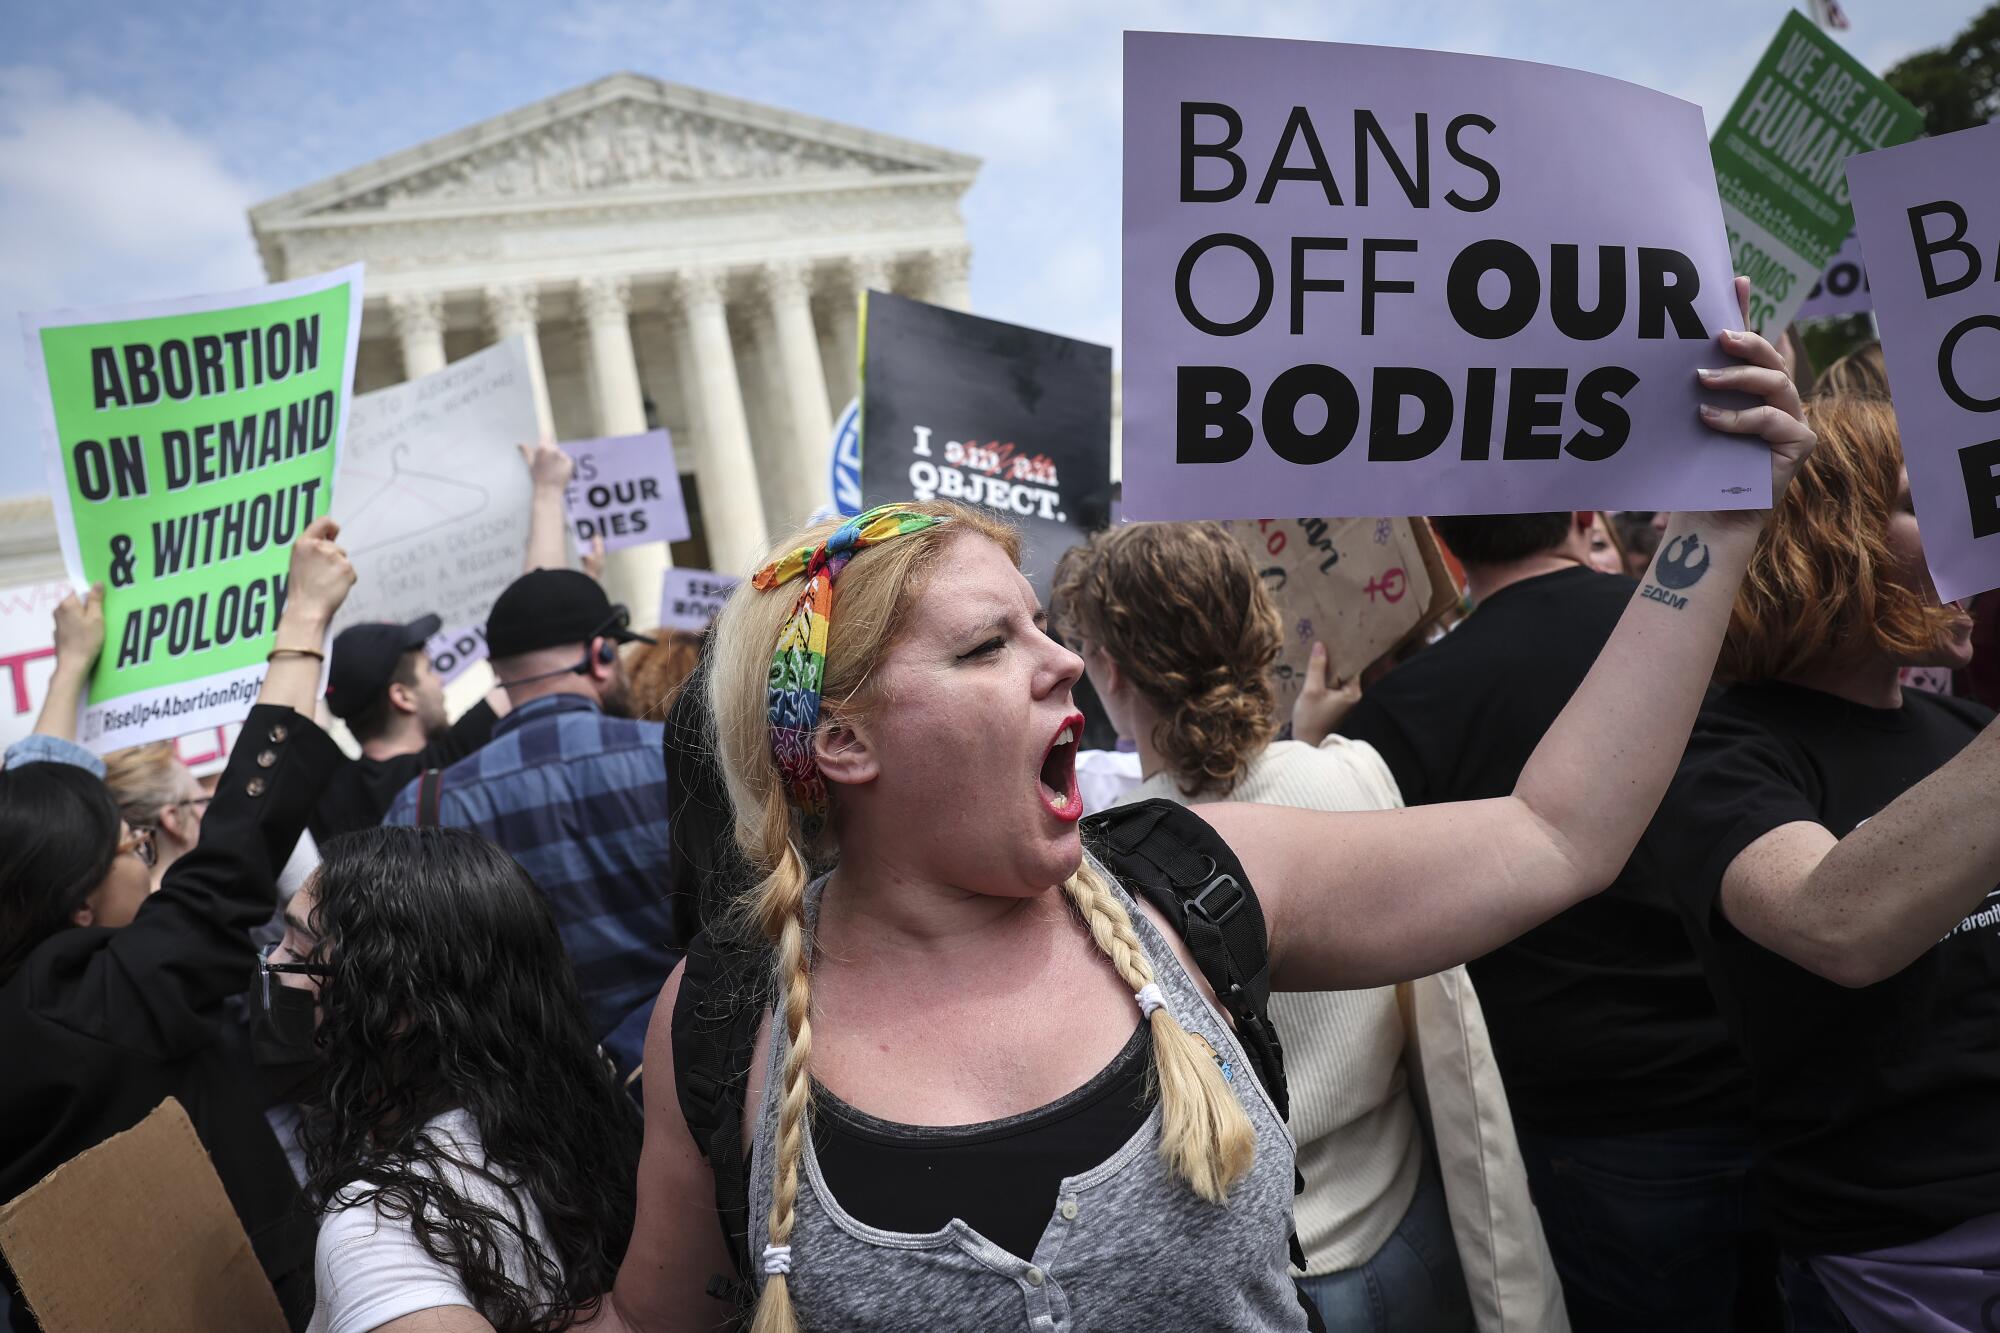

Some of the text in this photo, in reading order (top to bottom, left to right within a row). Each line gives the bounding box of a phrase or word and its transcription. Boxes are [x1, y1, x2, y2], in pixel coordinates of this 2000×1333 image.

[1776, 31, 1899, 150] WE ARE ALL
[1180, 101, 1501, 213] BANS
[1174, 232, 1418, 337] OFF
[1446, 239, 1710, 341] OUR
[1906, 200, 2000, 300] B
[90, 314, 319, 409] ABORTION
[73, 390, 334, 501] ON DEMAND
[913, 425, 932, 457] I
[1176, 365, 1641, 466] BODIES
[109, 477, 321, 588] & WITHOUT
[587, 478, 660, 509] OUR
[116, 573, 290, 669] APOLOGY
